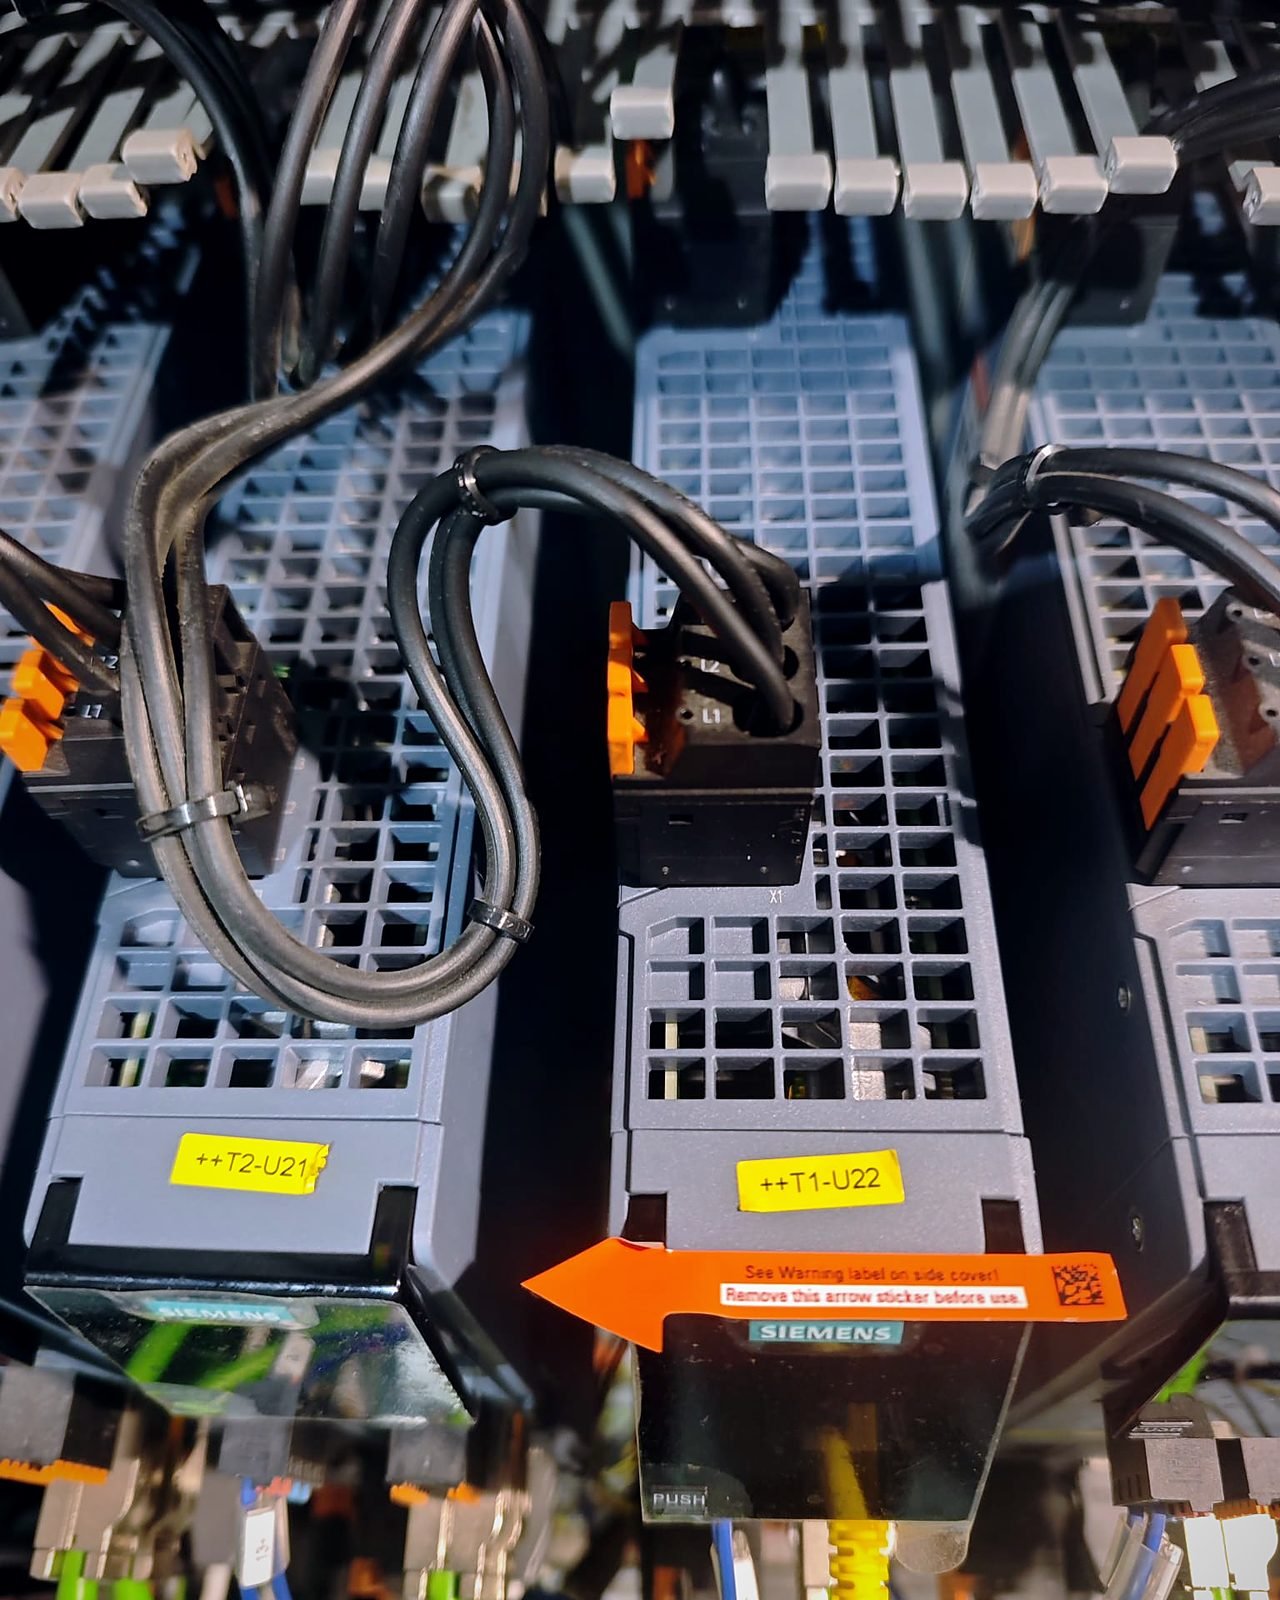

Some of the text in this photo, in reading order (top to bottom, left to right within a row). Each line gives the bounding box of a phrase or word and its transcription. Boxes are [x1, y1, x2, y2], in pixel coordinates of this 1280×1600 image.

[703, 708, 720, 724] L1
[769, 889, 783, 904] X1
[196, 1151, 308, 1178] ++T2-U21
[760, 1167, 881, 1193] ++T1-U22
[745, 1265, 1000, 1283] See Warning label on side cover!
[726, 1287, 788, 1302] Remove
[791, 1289, 821, 1303] this
[826, 1291, 872, 1303] arrow
[876, 1290, 929, 1304] sticker
[934, 1291, 986, 1304] before
[159, 1307, 281, 1322] SIEMENS
[760, 1324, 892, 1341] SIEMENS
[653, 1493, 706, 1505] PUSH
